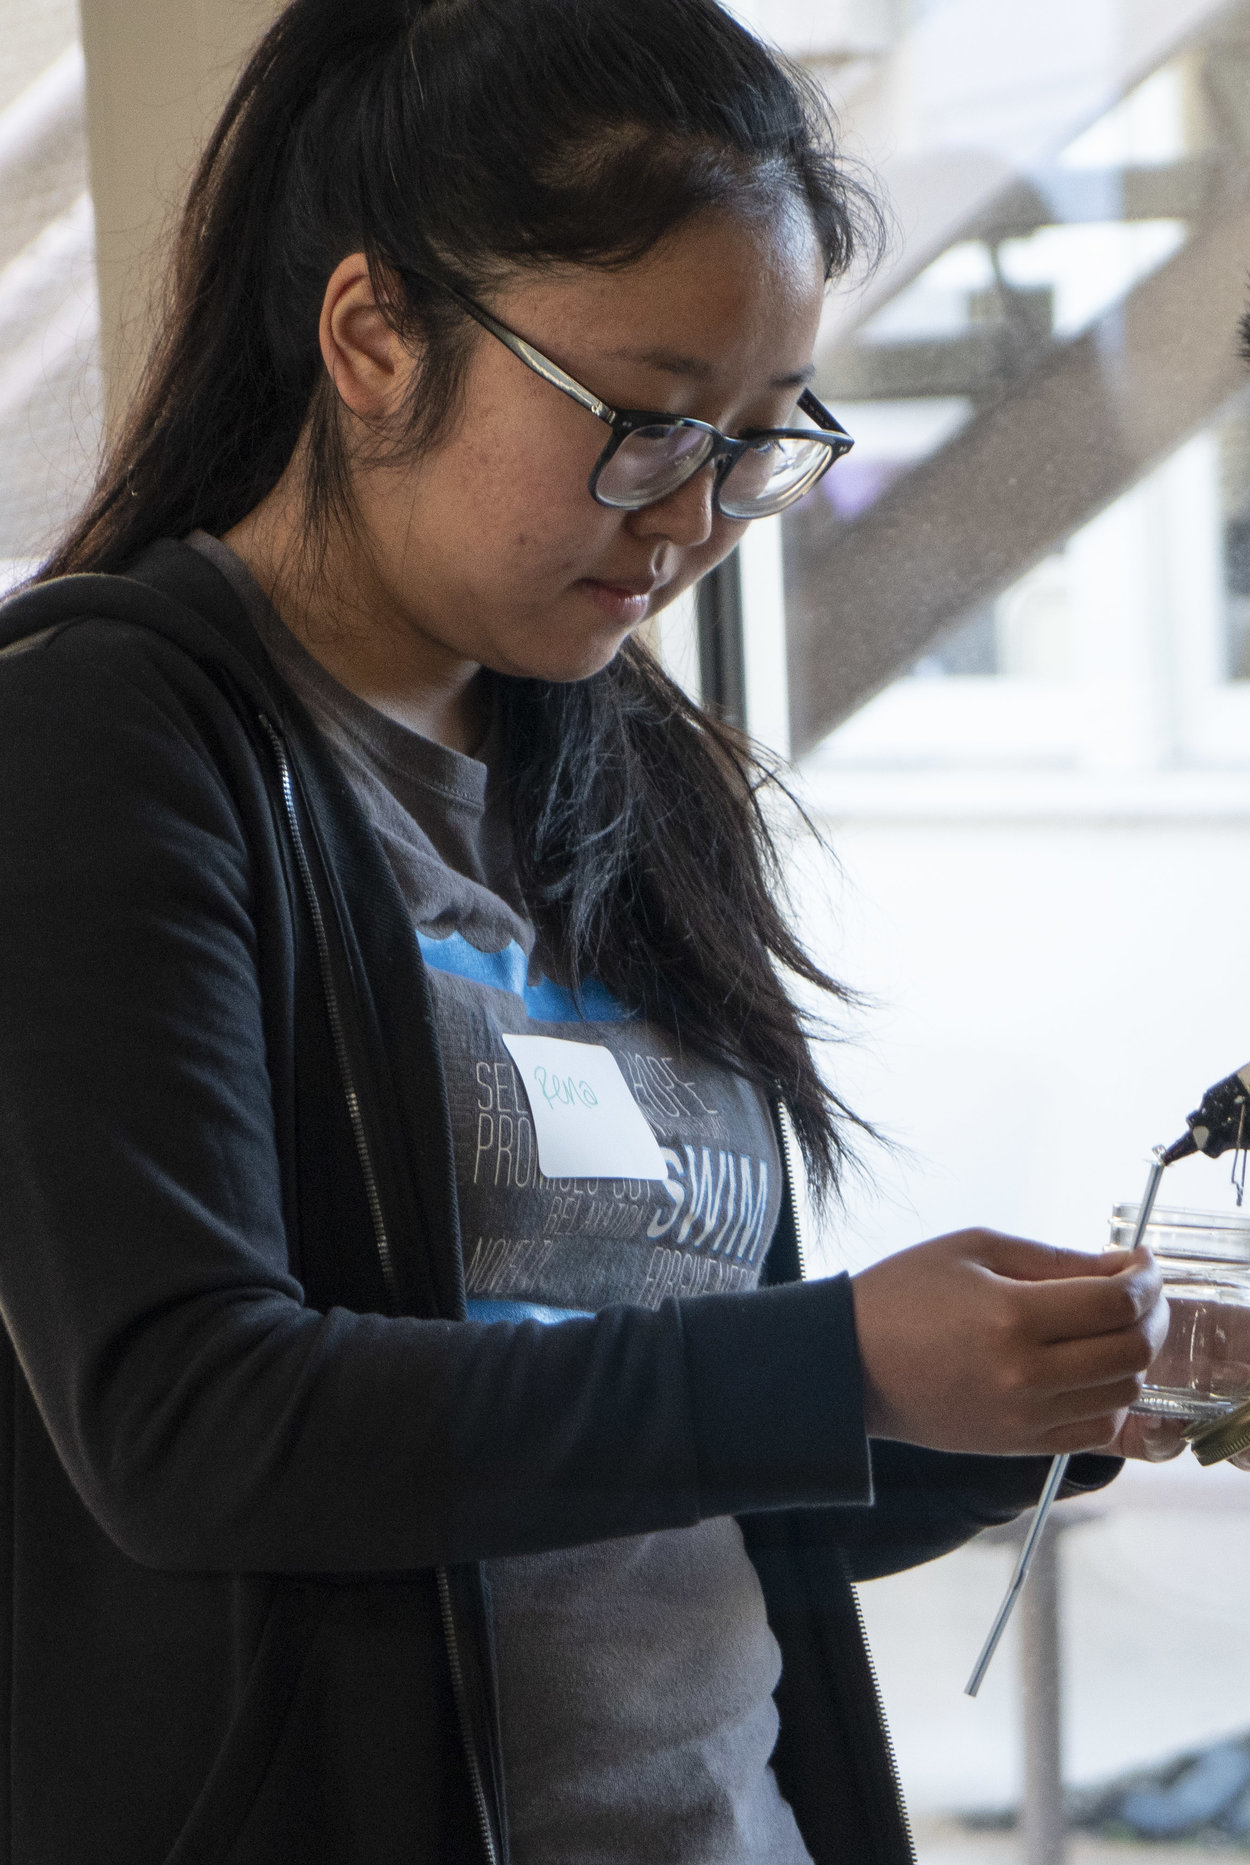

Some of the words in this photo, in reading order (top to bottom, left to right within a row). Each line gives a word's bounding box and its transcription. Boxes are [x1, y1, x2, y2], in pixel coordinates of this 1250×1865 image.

[476, 1061, 529, 1115] SEL
[617, 1047, 719, 1119] HOPE
[646, 1144, 769, 1263] SWIM
